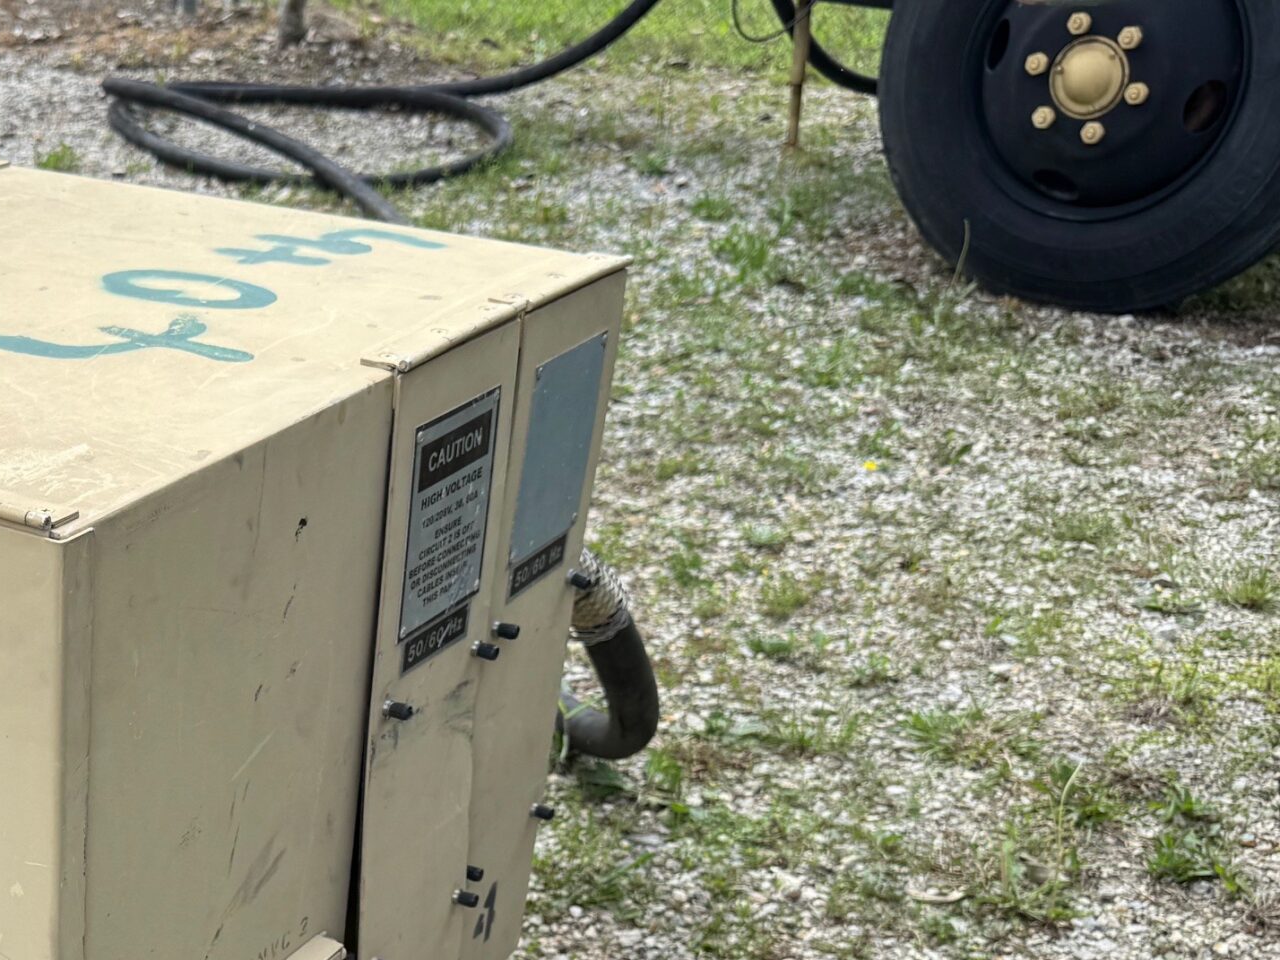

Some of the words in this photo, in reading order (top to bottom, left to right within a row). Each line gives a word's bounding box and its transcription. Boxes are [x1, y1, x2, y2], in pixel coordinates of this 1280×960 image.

[428, 427, 483, 472] CAUTION
[421, 489, 443, 511] HIGH
[445, 466, 483, 497] VOLTAGE
[419, 535, 447, 560] CIRCUIT
[448, 533, 453, 543] 2
[454, 528, 461, 540] IS
[434, 515, 462, 539] ENSURE
[409, 556, 436, 579] BEFORE
[438, 529, 481, 562] CONNECTING
[411, 577, 421, 590] OR
[422, 543, 477, 583] DISCONNECTING
[417, 575, 444, 598] CABLES
[423, 590, 438, 607] THIS
[407, 627, 443, 663] 50/60
[448, 614, 464, 636] Hz
